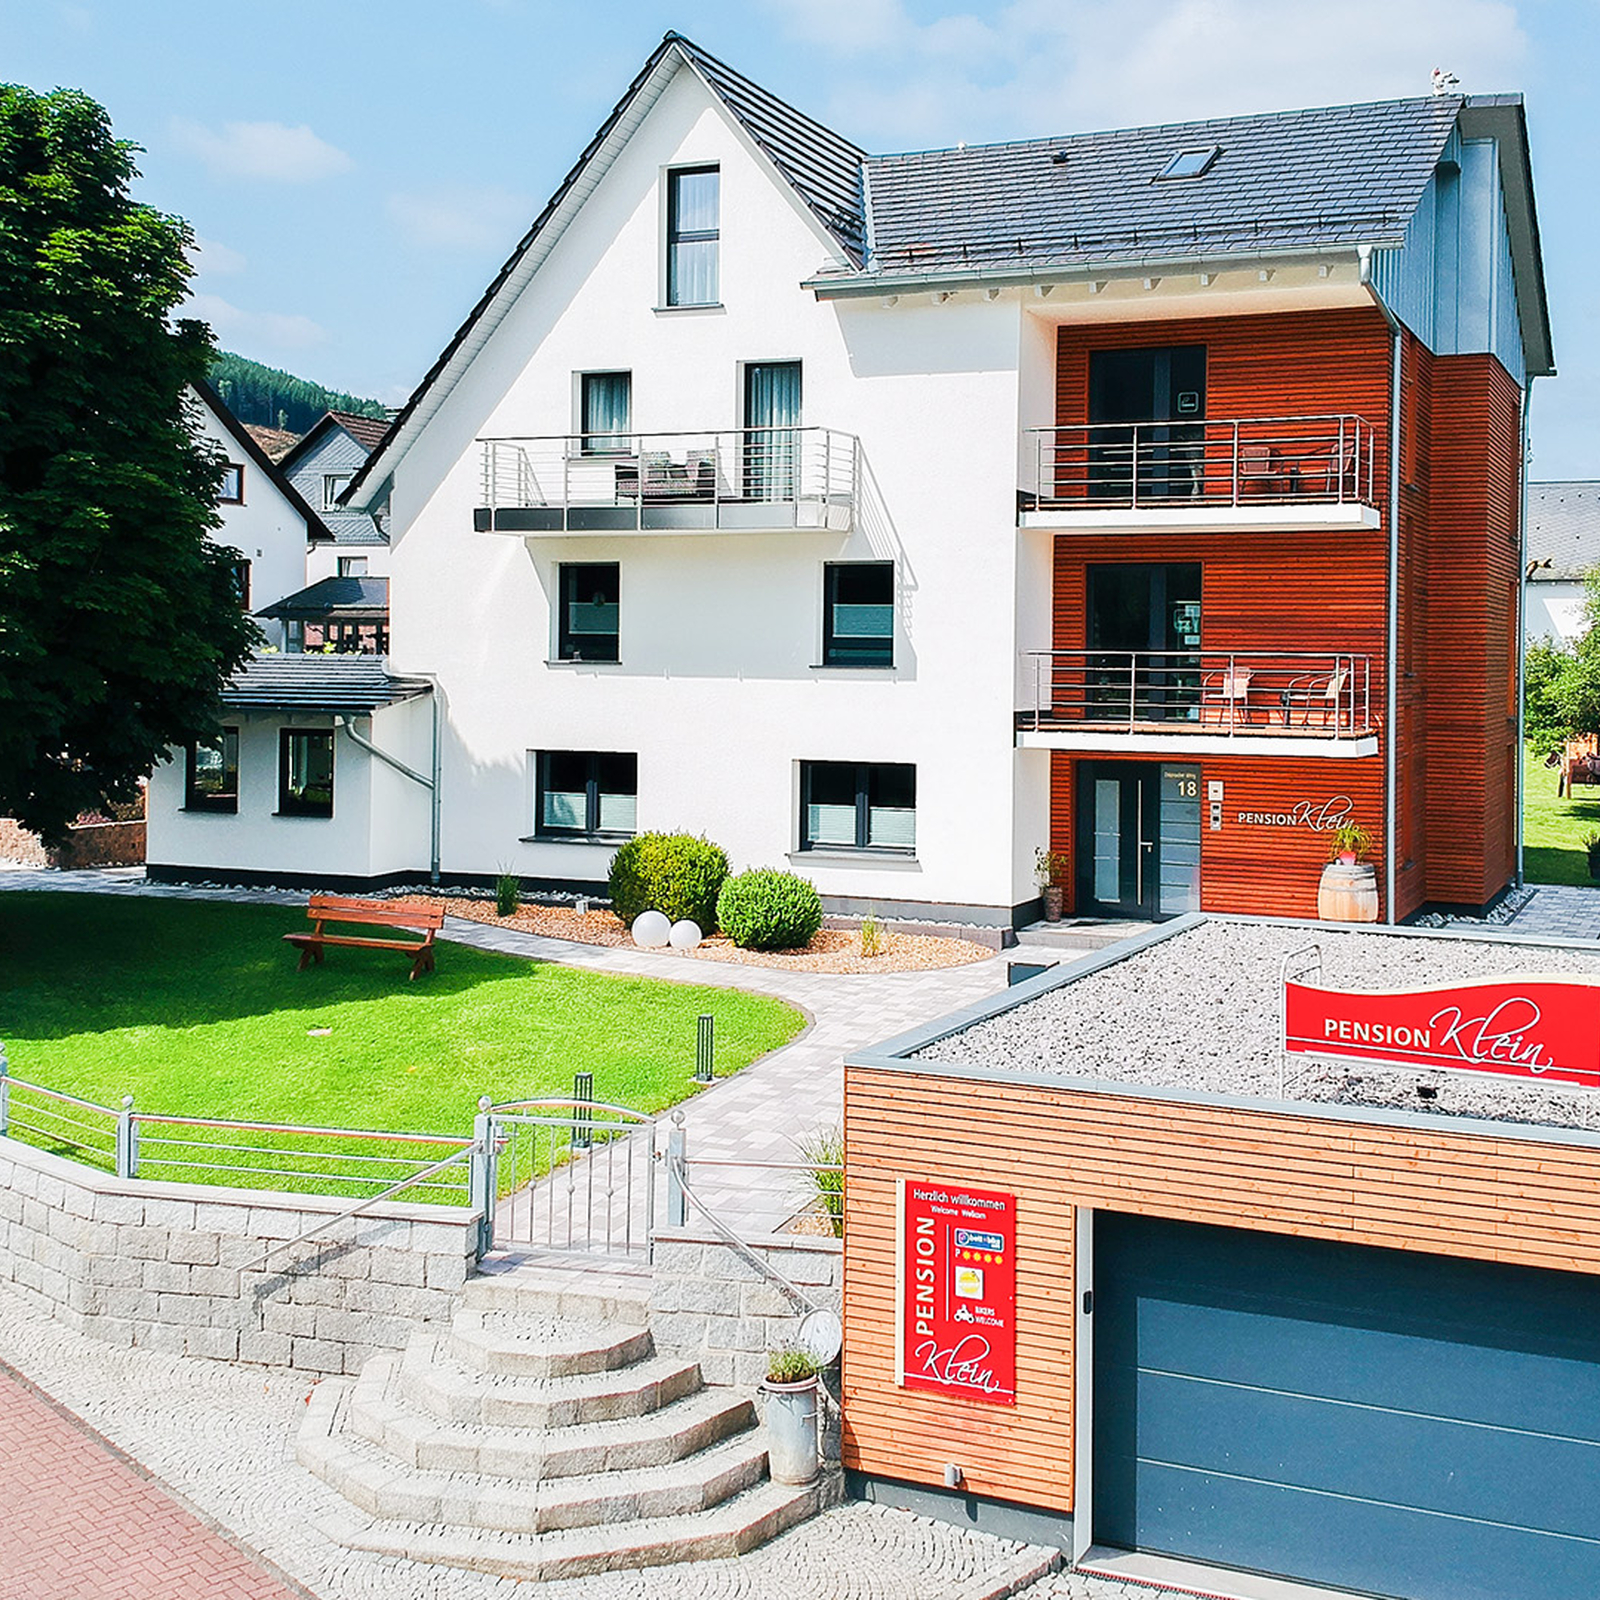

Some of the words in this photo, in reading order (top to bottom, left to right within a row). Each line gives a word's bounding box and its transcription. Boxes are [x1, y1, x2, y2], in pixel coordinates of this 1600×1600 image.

[1178, 781, 1197, 797] 18
[1238, 812, 1297, 826] PENSION
[1292, 795, 1360, 832] Klein
[1324, 1018, 1430, 1048] PENSION
[1429, 997, 1554, 1074] Klein
[913, 1188, 949, 1203] Herzlich
[950, 1193, 1006, 1211] willkommen
[915, 1216, 936, 1336] PENSION
[914, 1334, 1000, 1393] Klein
